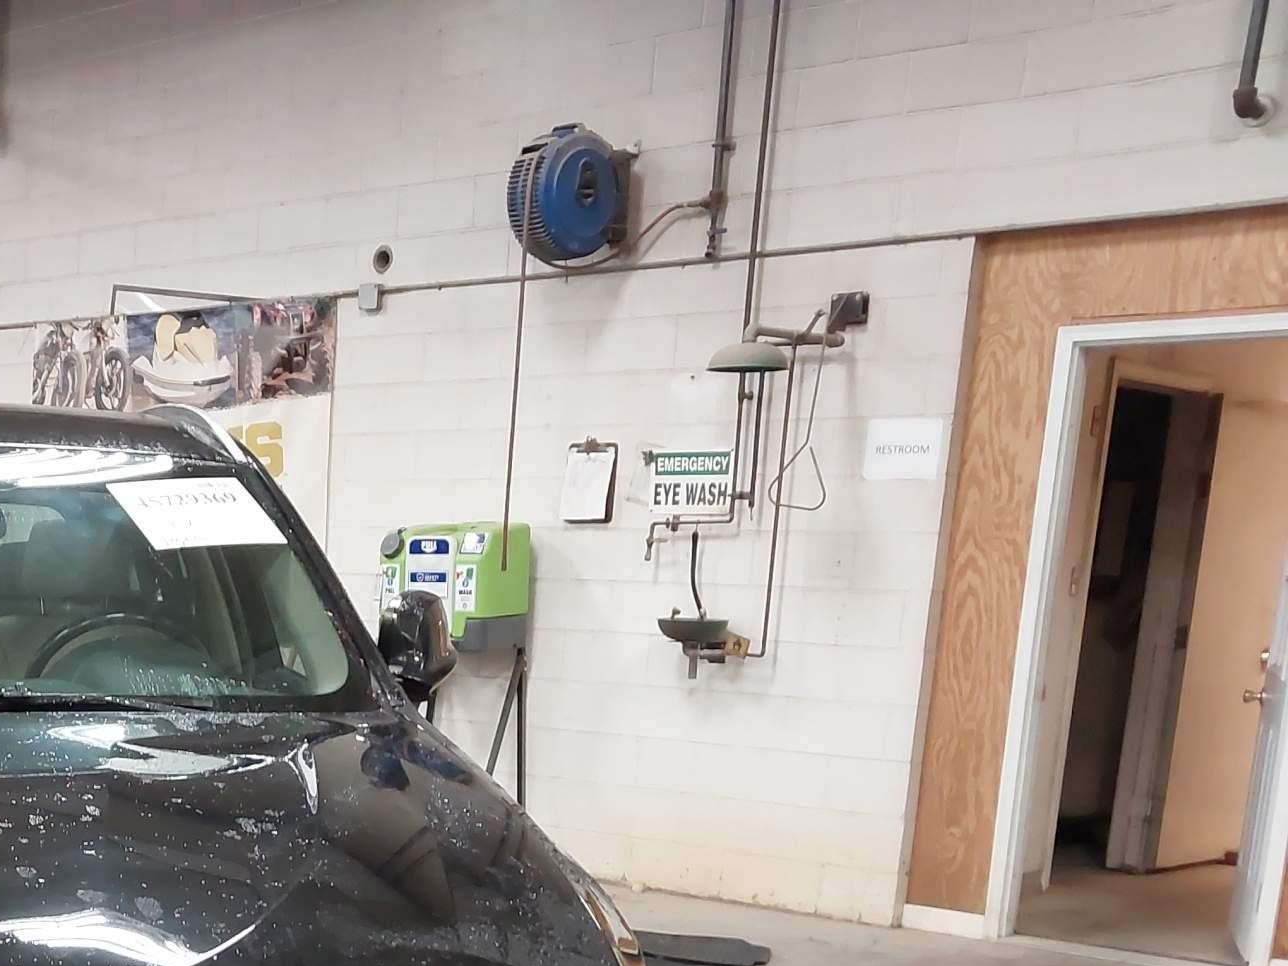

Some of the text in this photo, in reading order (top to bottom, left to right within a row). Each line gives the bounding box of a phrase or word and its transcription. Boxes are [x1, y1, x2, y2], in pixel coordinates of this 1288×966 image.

[875, 444, 930, 454] RESTROOM
[657, 456, 729, 472] EMERGENCY
[654, 482, 728, 505] EYE WASH
